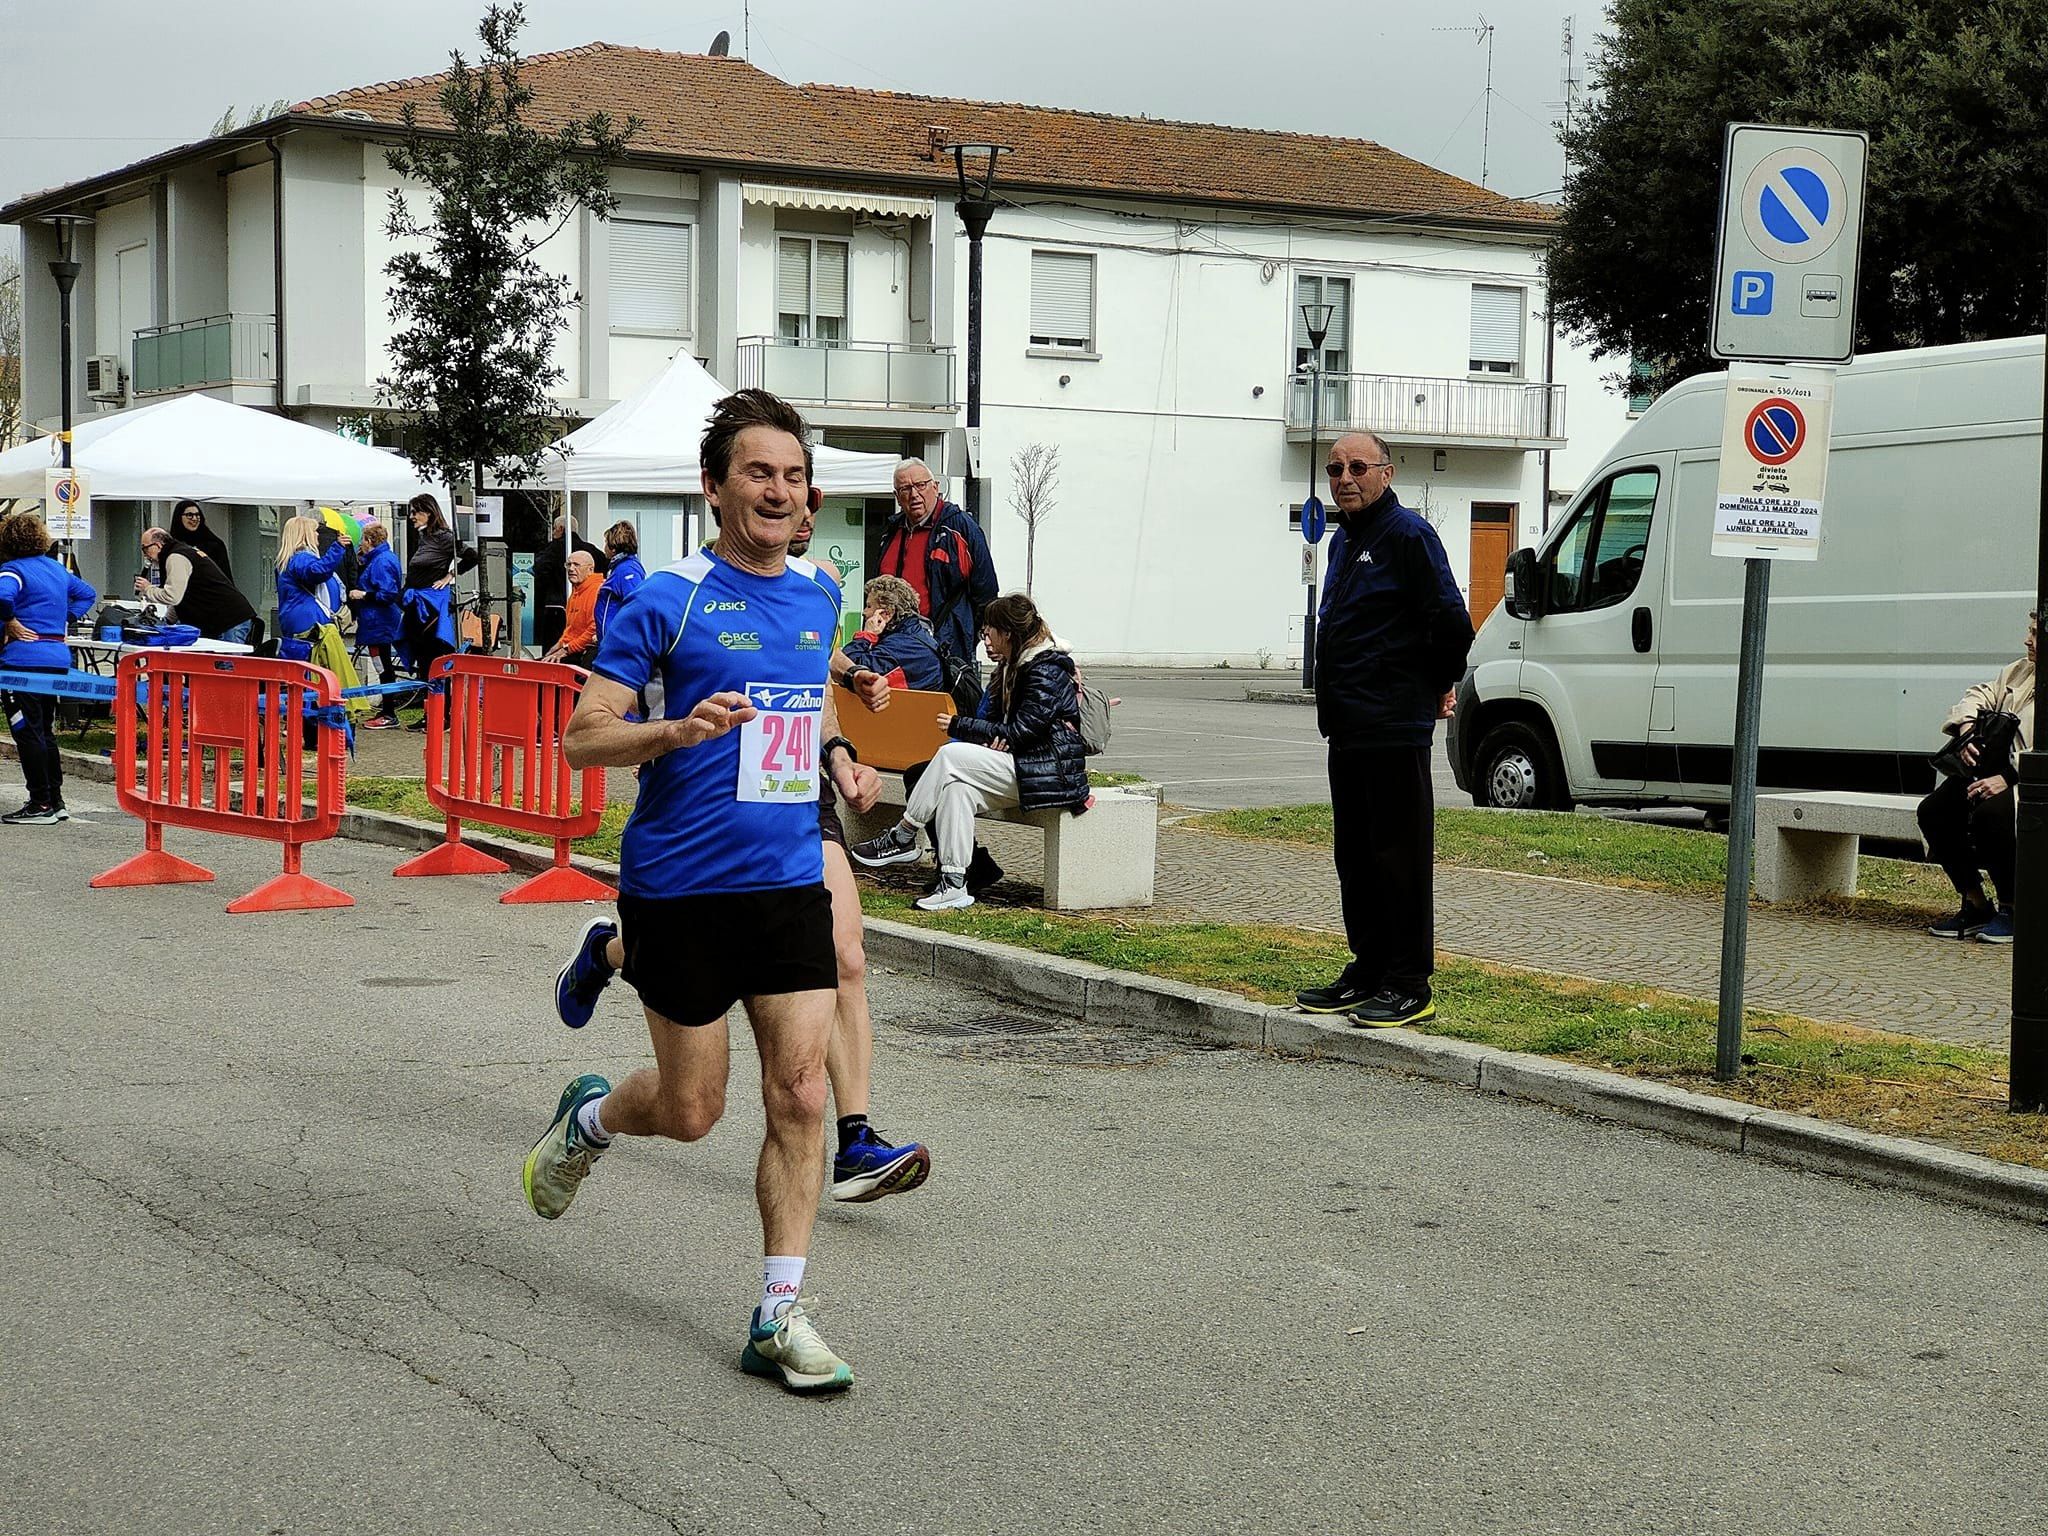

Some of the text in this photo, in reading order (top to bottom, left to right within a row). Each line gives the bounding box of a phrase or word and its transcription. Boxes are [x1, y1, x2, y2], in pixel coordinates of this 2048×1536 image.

[1739, 276, 1766, 310] P
[1759, 466, 1786, 474] divieto
[1740, 497, 1762, 505] DALLE
[1719, 503, 1759, 511] DOMENICA
[1772, 506, 1798, 514] MARZO
[1762, 526, 1789, 535] APRILE
[1790, 528, 1808, 536] 2024
[732, 632, 759, 641] BCC
[761, 715, 811, 772] 240
